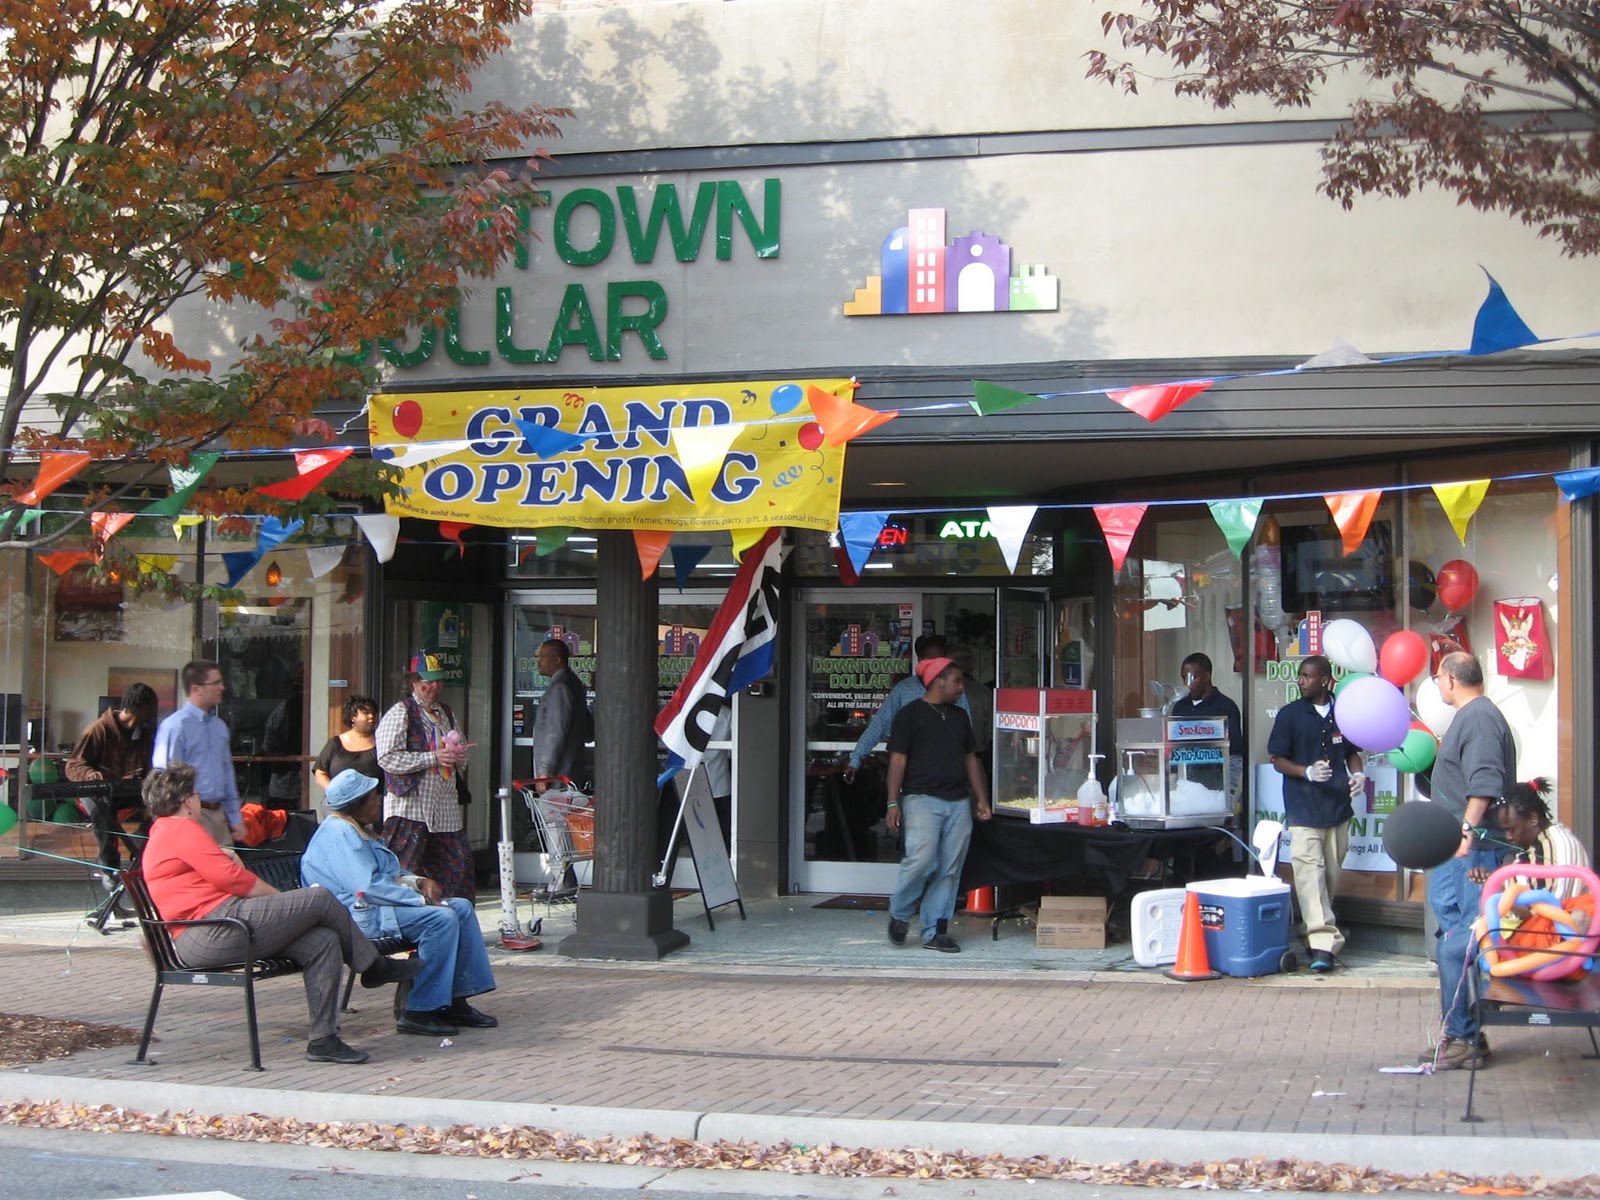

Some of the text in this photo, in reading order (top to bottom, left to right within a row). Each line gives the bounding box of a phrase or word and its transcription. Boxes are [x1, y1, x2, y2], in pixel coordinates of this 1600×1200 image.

[322, 279, 668, 369] OLLAR
[466, 398, 732, 457] GRAND
[424, 452, 762, 506] OPENING
[607, 516, 631, 525] photo
[771, 512, 805, 522] seasonal
[877, 526, 909, 545] EN
[940, 521, 998, 538] ATM
[813, 657, 910, 673] DOWNTOWN
[829, 673, 892, 689] DOLLAR
